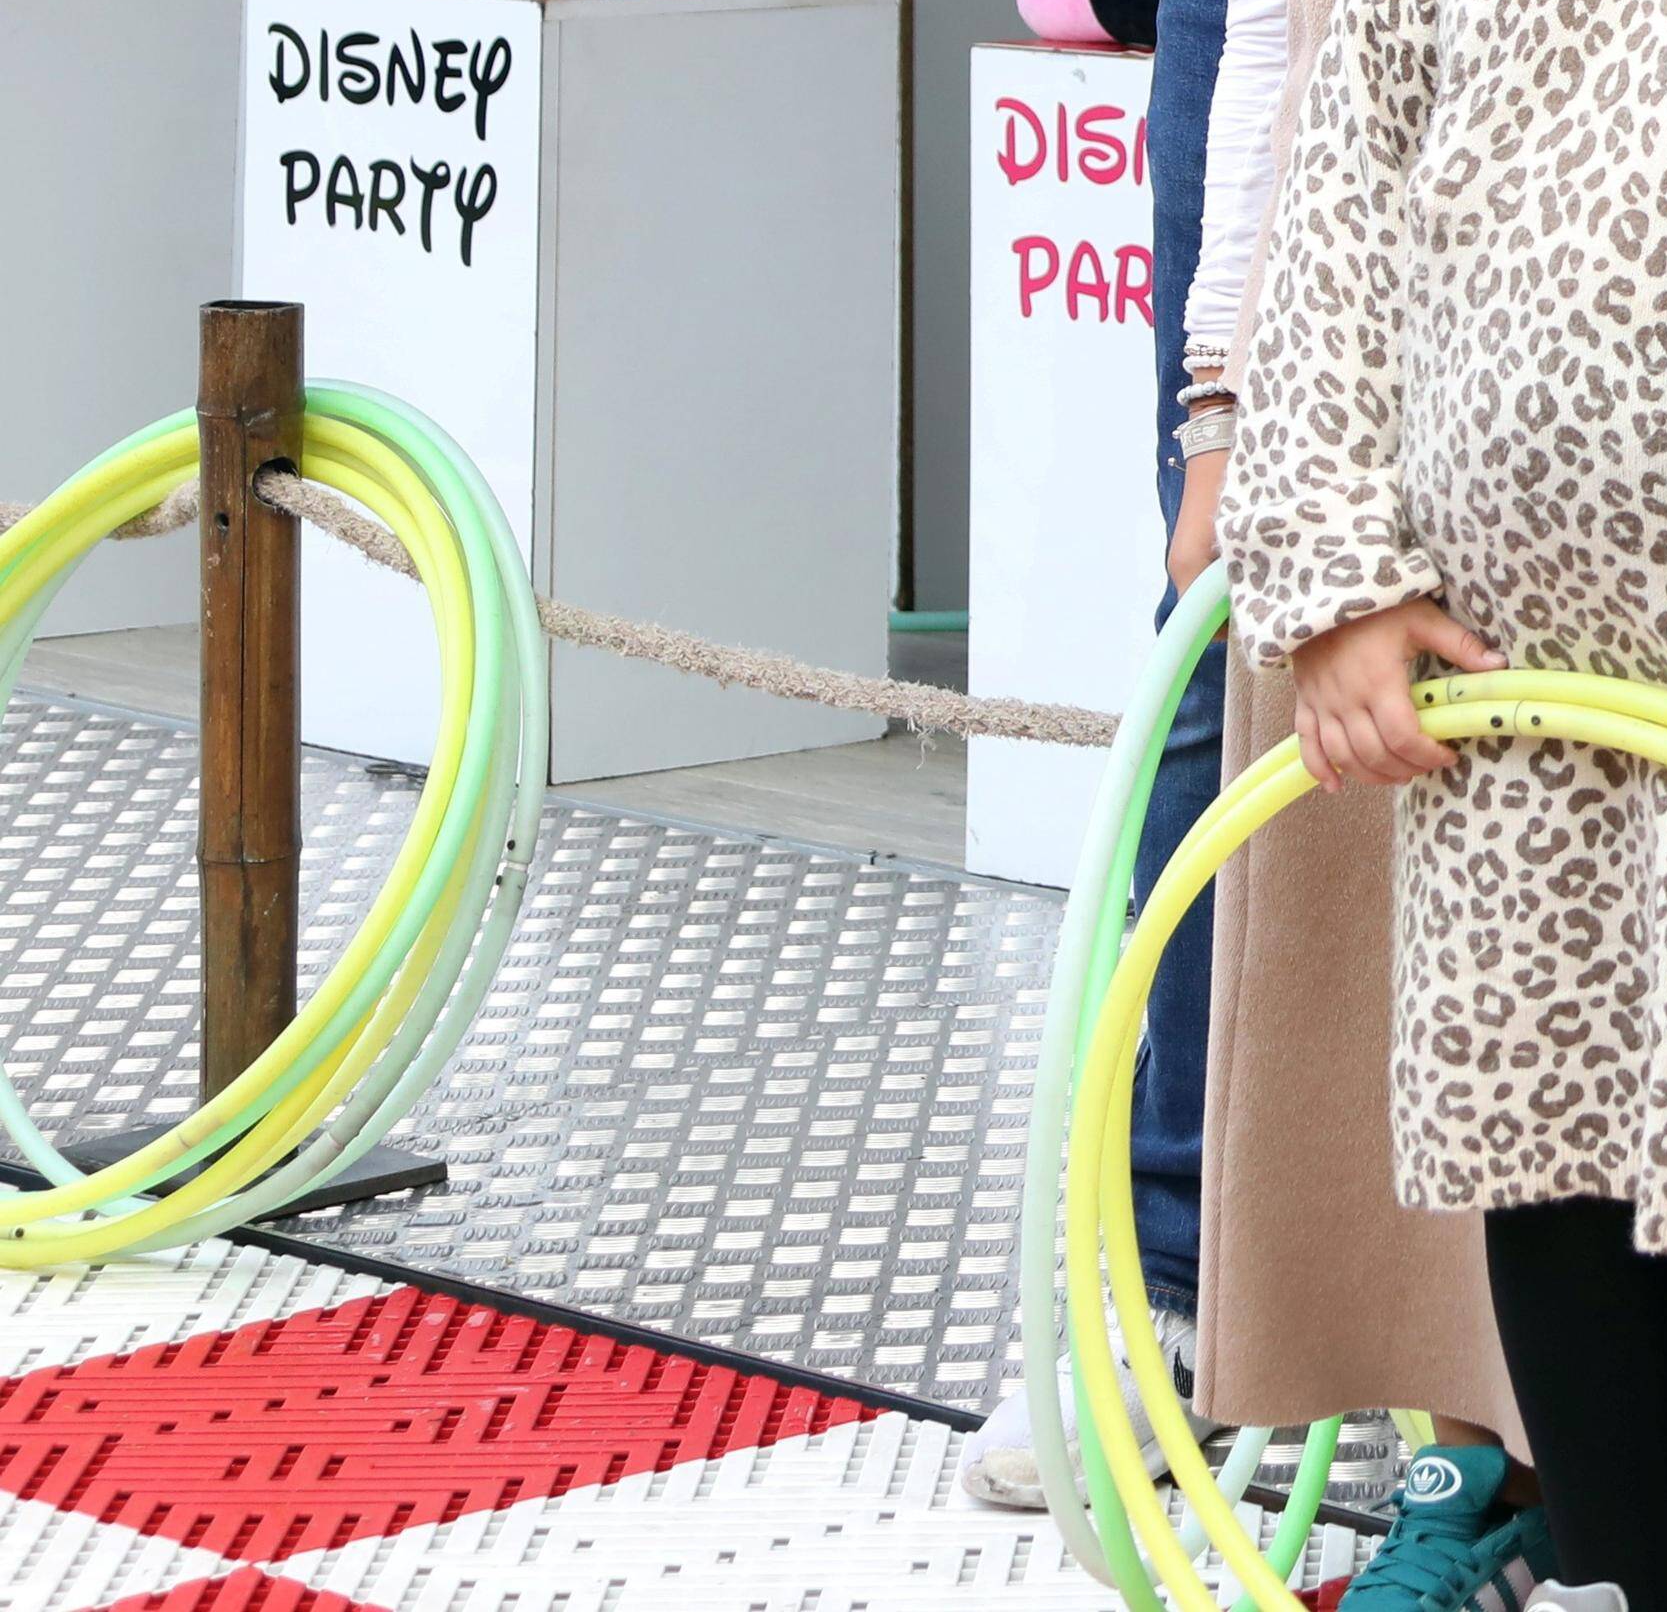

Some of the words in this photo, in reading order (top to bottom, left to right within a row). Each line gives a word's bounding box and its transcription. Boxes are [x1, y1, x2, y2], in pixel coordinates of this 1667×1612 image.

[267, 23, 513, 141] DISNEY
[995, 95, 1147, 187] DIS
[280, 149, 499, 267] PARTY
[1011, 234, 1154, 328] PAR
